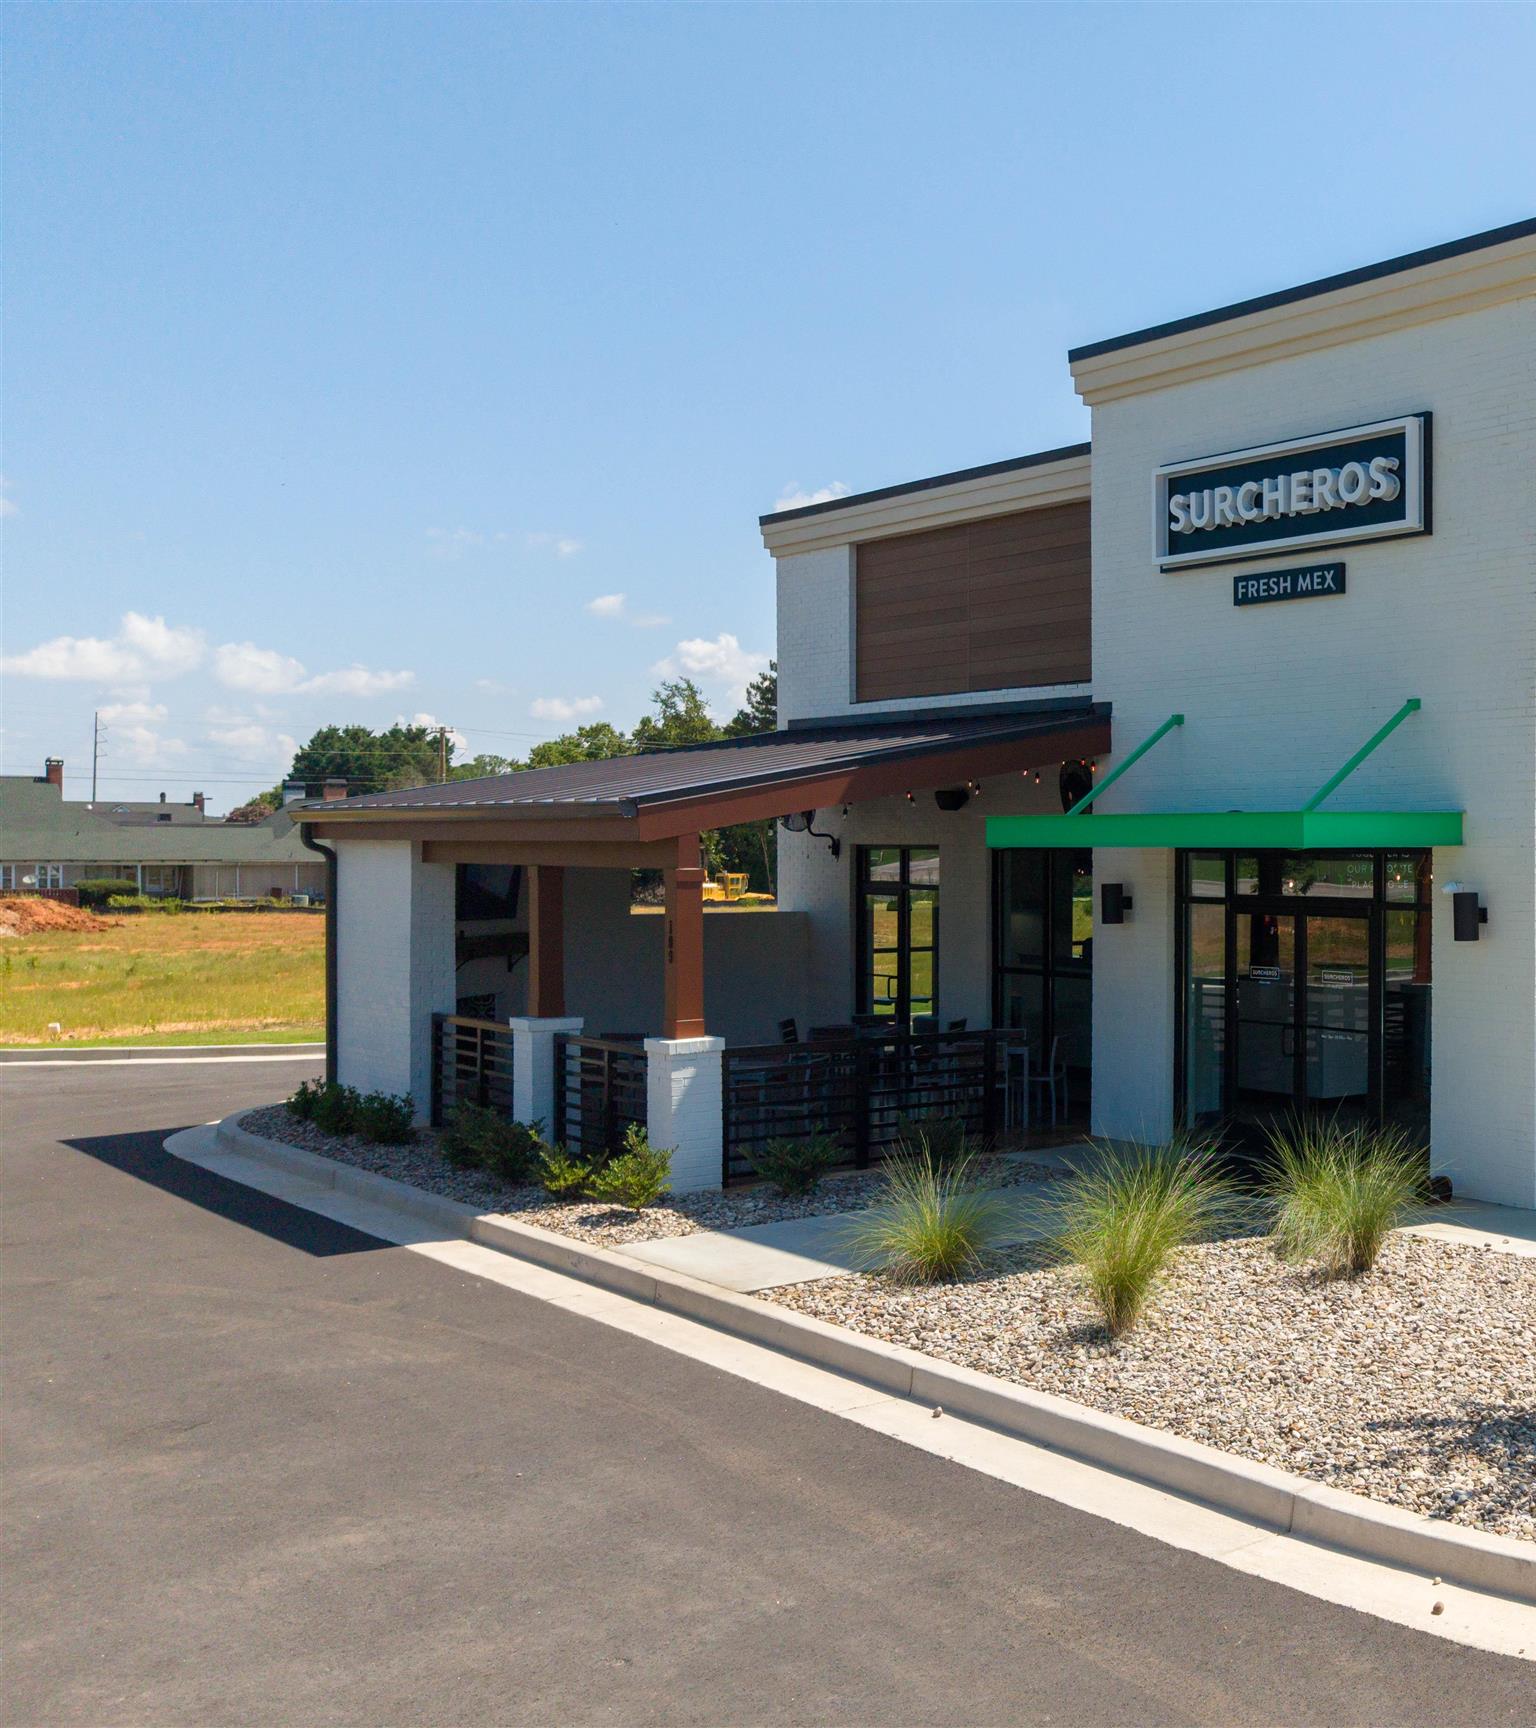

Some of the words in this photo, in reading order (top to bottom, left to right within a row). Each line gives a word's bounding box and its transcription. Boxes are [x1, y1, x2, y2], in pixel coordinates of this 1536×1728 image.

[1169, 456, 1400, 534] SURCHEROS
[1238, 575, 1291, 599] FRESH
[1297, 569, 1336, 592] MEX
